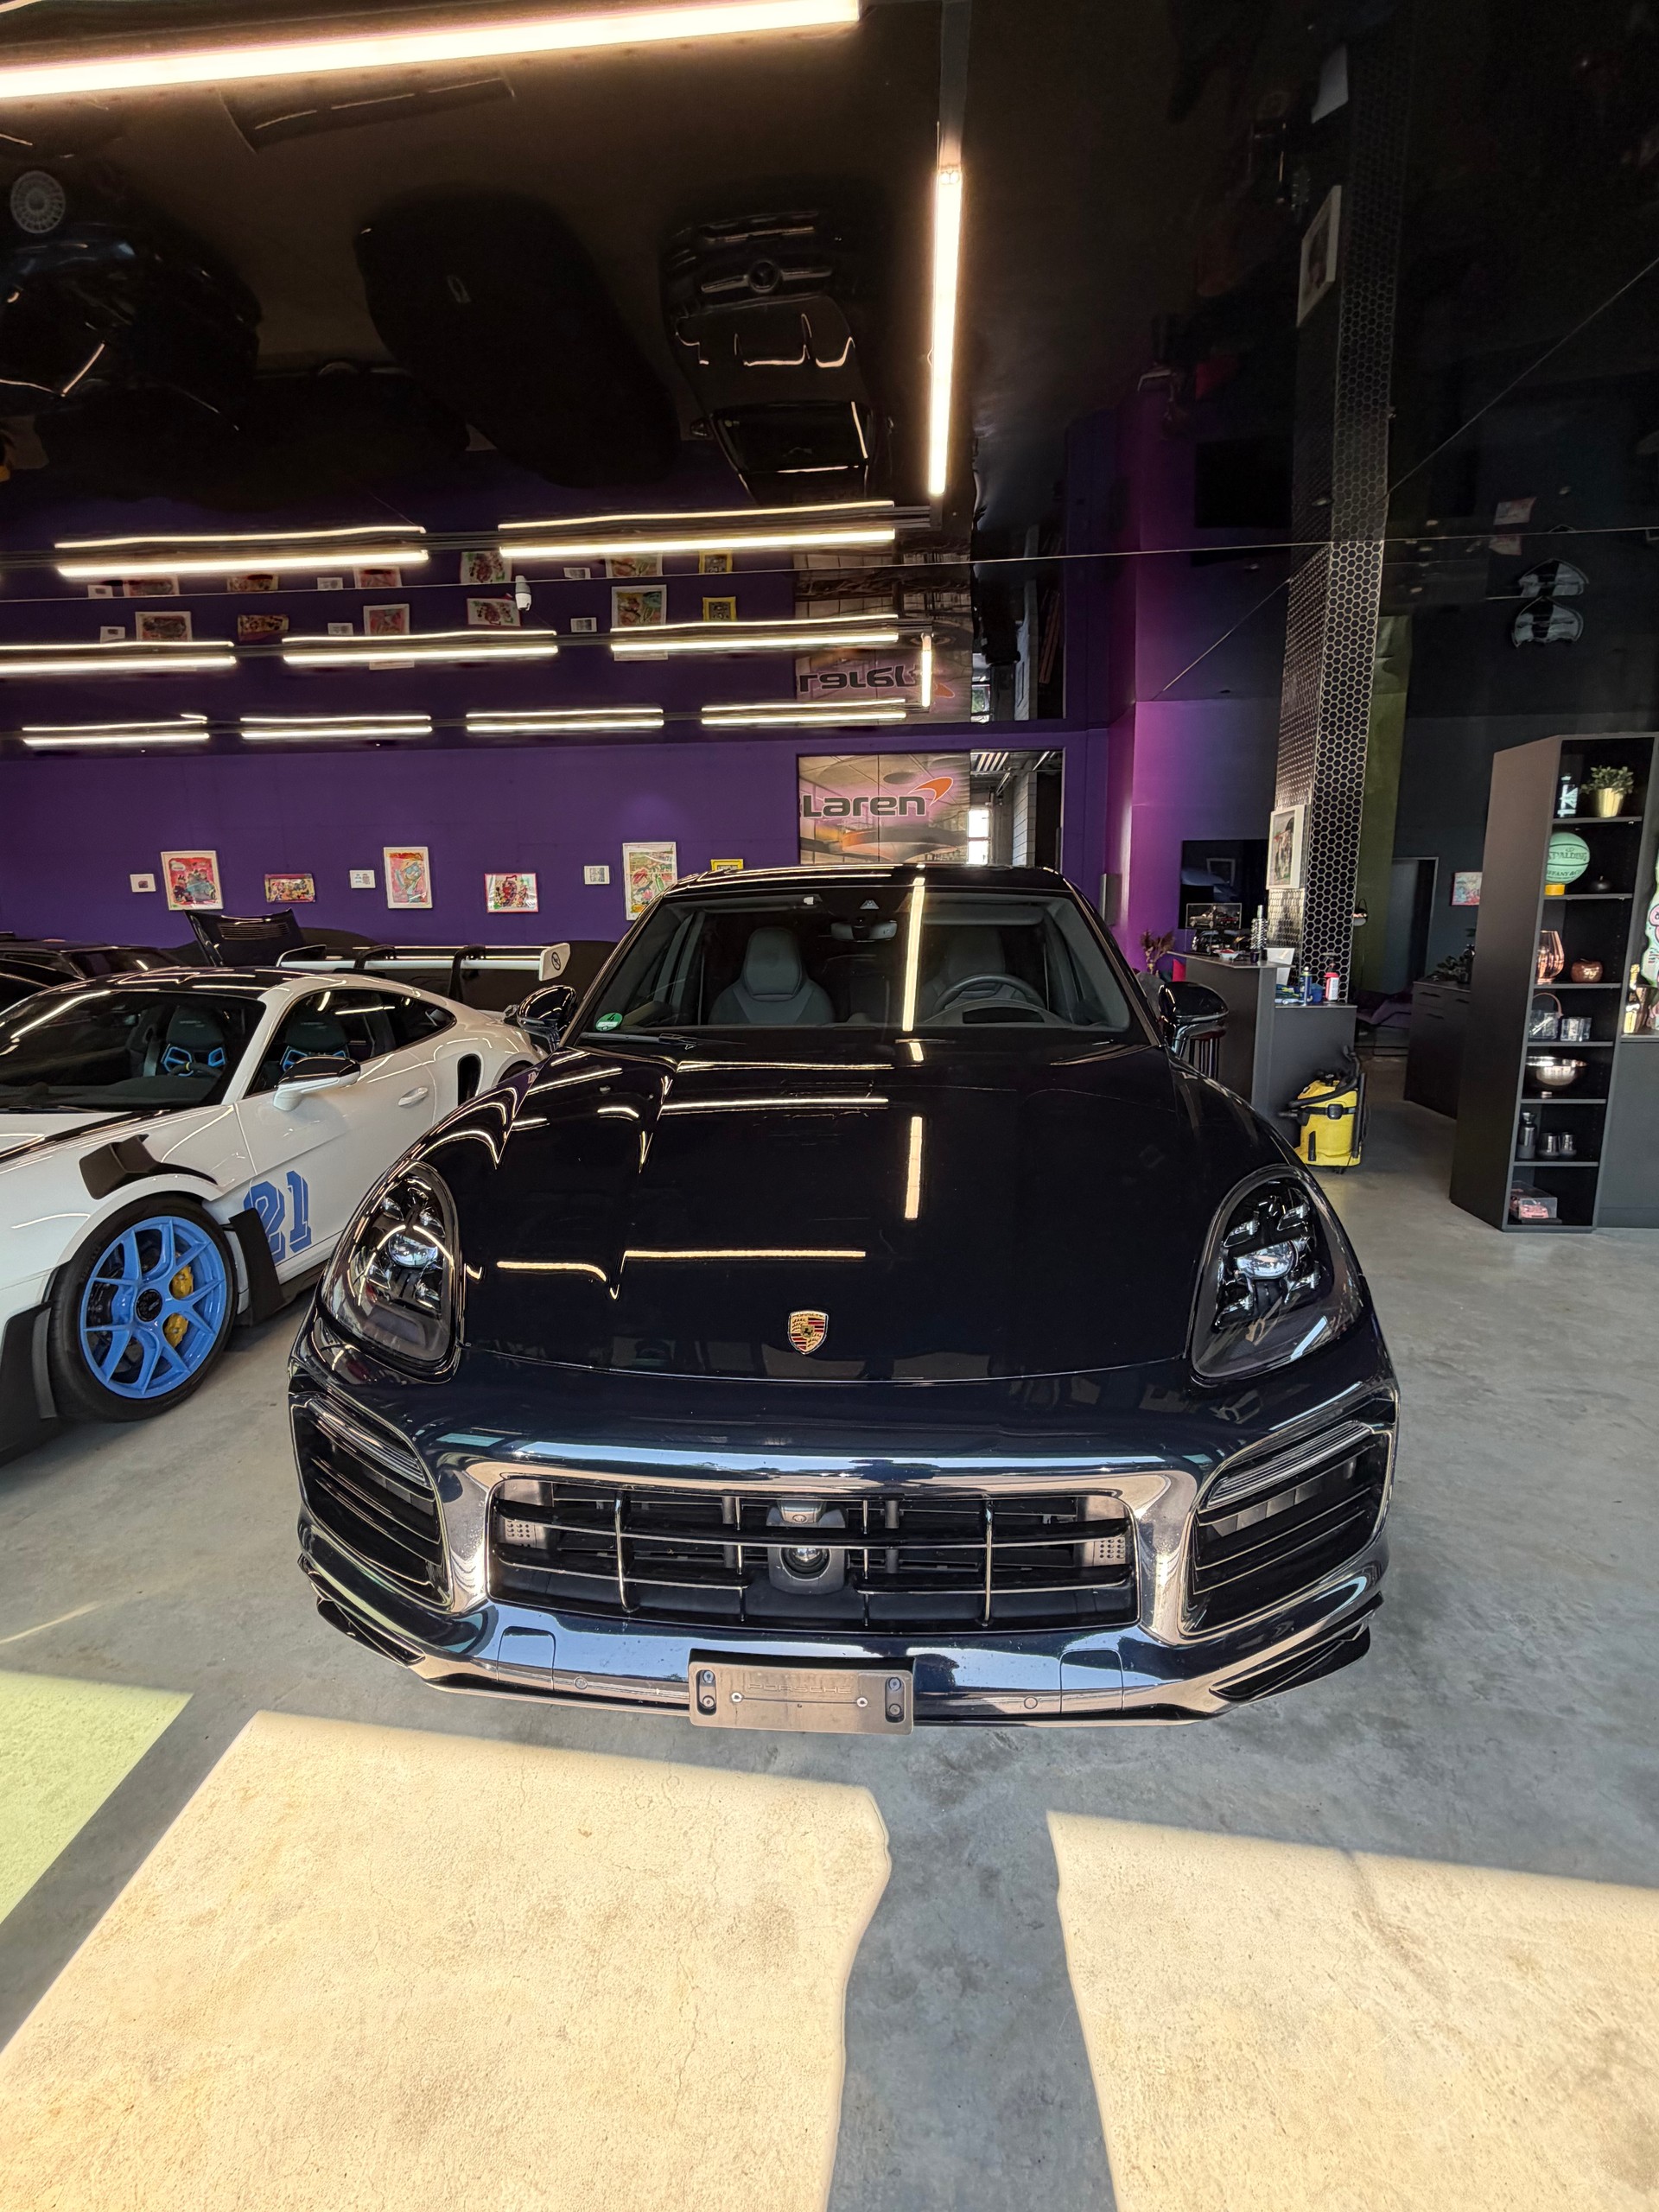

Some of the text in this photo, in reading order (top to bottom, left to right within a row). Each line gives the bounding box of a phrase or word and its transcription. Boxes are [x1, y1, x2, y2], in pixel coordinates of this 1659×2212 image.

[802, 794, 926, 818] Laren
[243, 1170, 312, 1265] 21
[747, 1683, 852, 1694] PORSCHE
